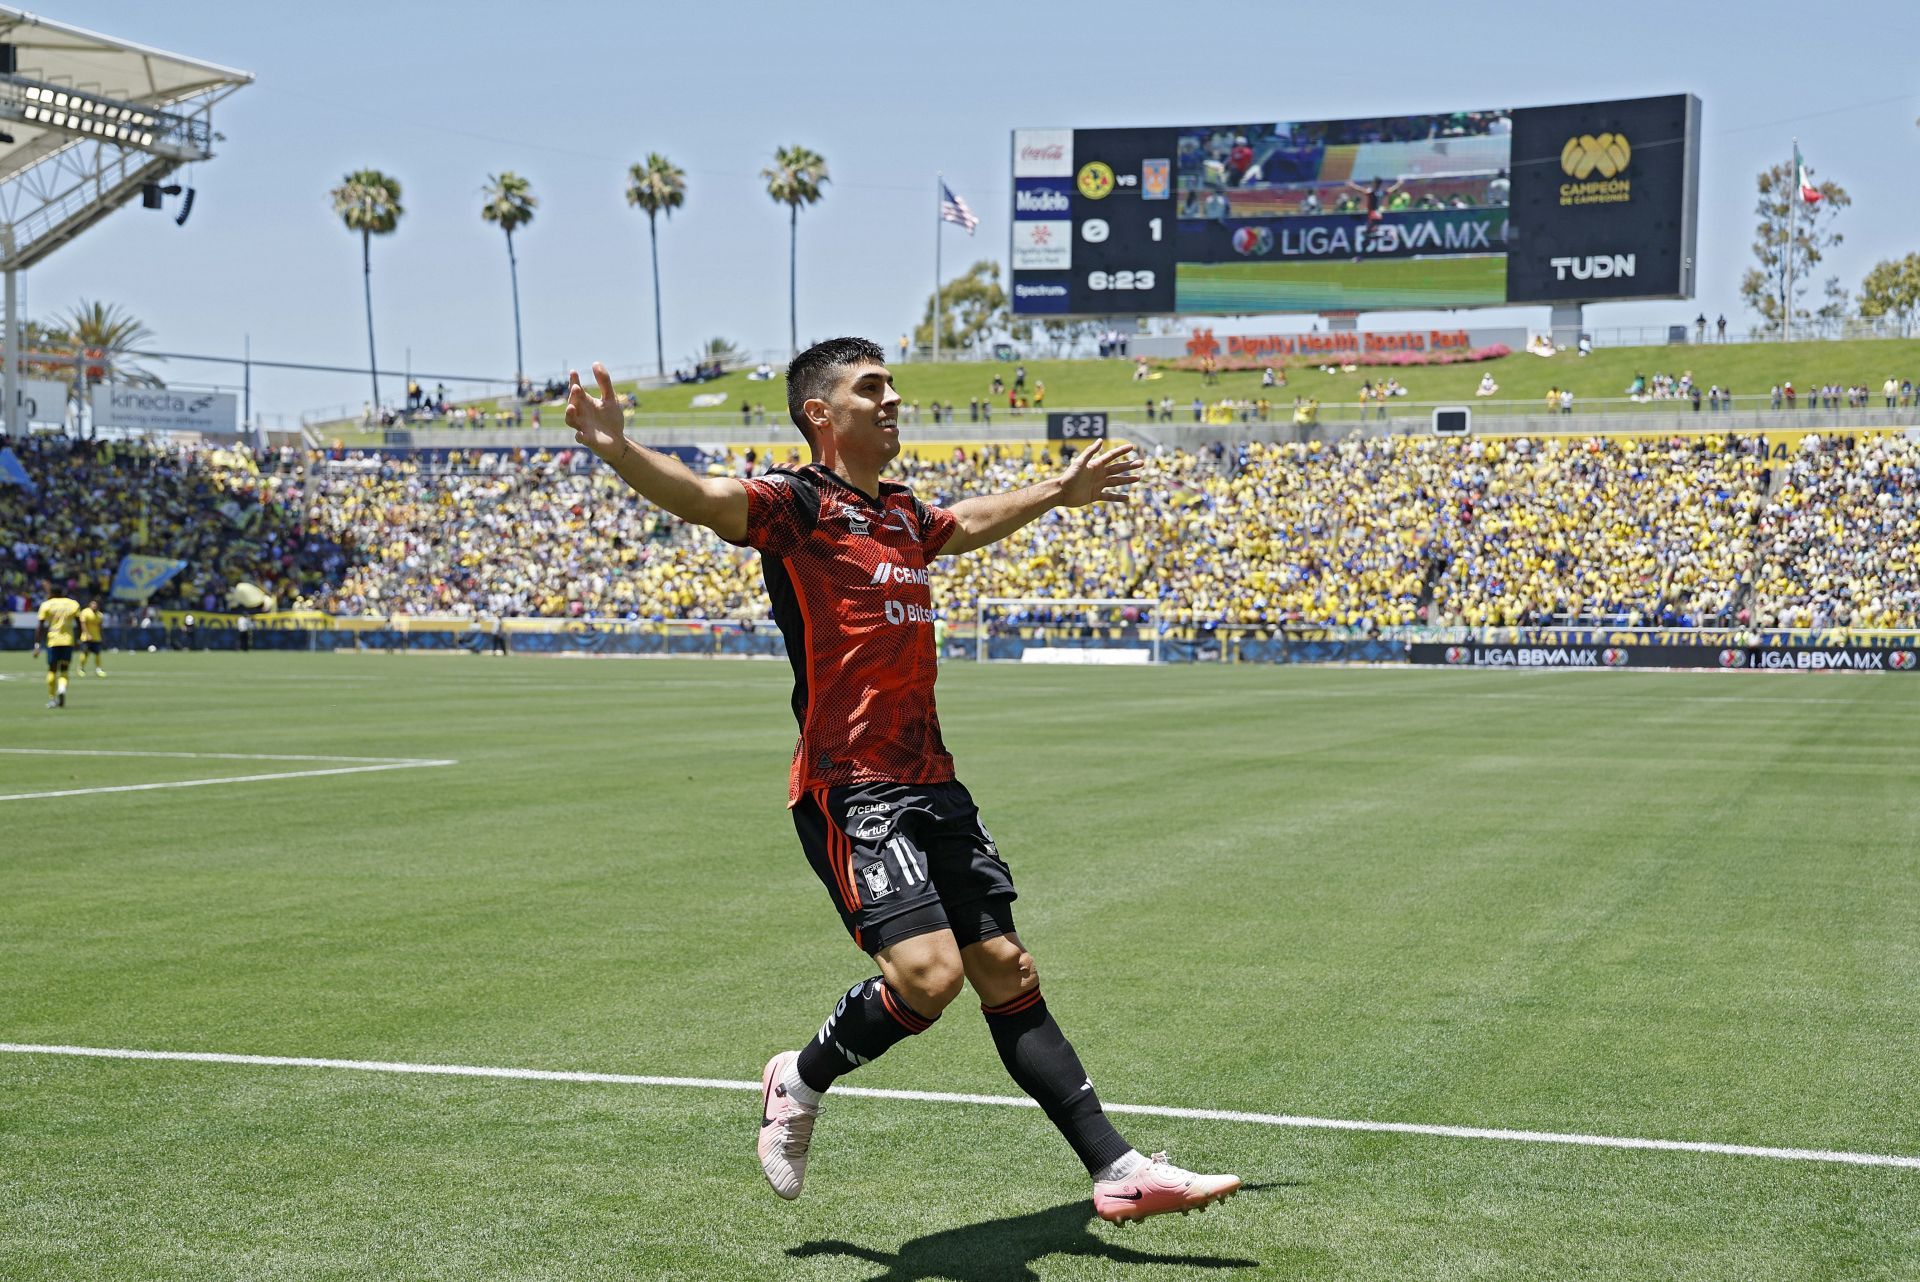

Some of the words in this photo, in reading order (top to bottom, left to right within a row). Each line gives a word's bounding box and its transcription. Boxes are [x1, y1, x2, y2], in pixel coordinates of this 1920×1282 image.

[1559, 179, 1631, 197] CAMPEÓN
[1016, 190, 1070, 212] Modelo
[1149, 217, 1163, 242] 1
[1282, 226, 1351, 255] LIGA
[1445, 220, 1491, 249] MX
[1550, 253, 1636, 281] TUDN
[1015, 283, 1064, 299] Spectrum
[1087, 270, 1156, 291] 6:23
[1227, 334, 1294, 355] Dignity
[1297, 331, 1359, 352] Health
[1364, 331, 1424, 350] Sports
[1429, 328, 1470, 349] Park
[110, 388, 186, 412] kinecta
[1062, 415, 1105, 438] 6:23
[893, 565, 930, 585] CEME
[1474, 648, 1517, 666] LIGA
[1517, 648, 1570, 666] BBVA
[1570, 648, 1598, 666] MX
[1797, 650, 1853, 668] BBVA
[1854, 651, 1883, 669] MX
[857, 803, 892, 815] CEMEX
[856, 824, 888, 838] Vertua
[885, 836, 926, 886] 11
